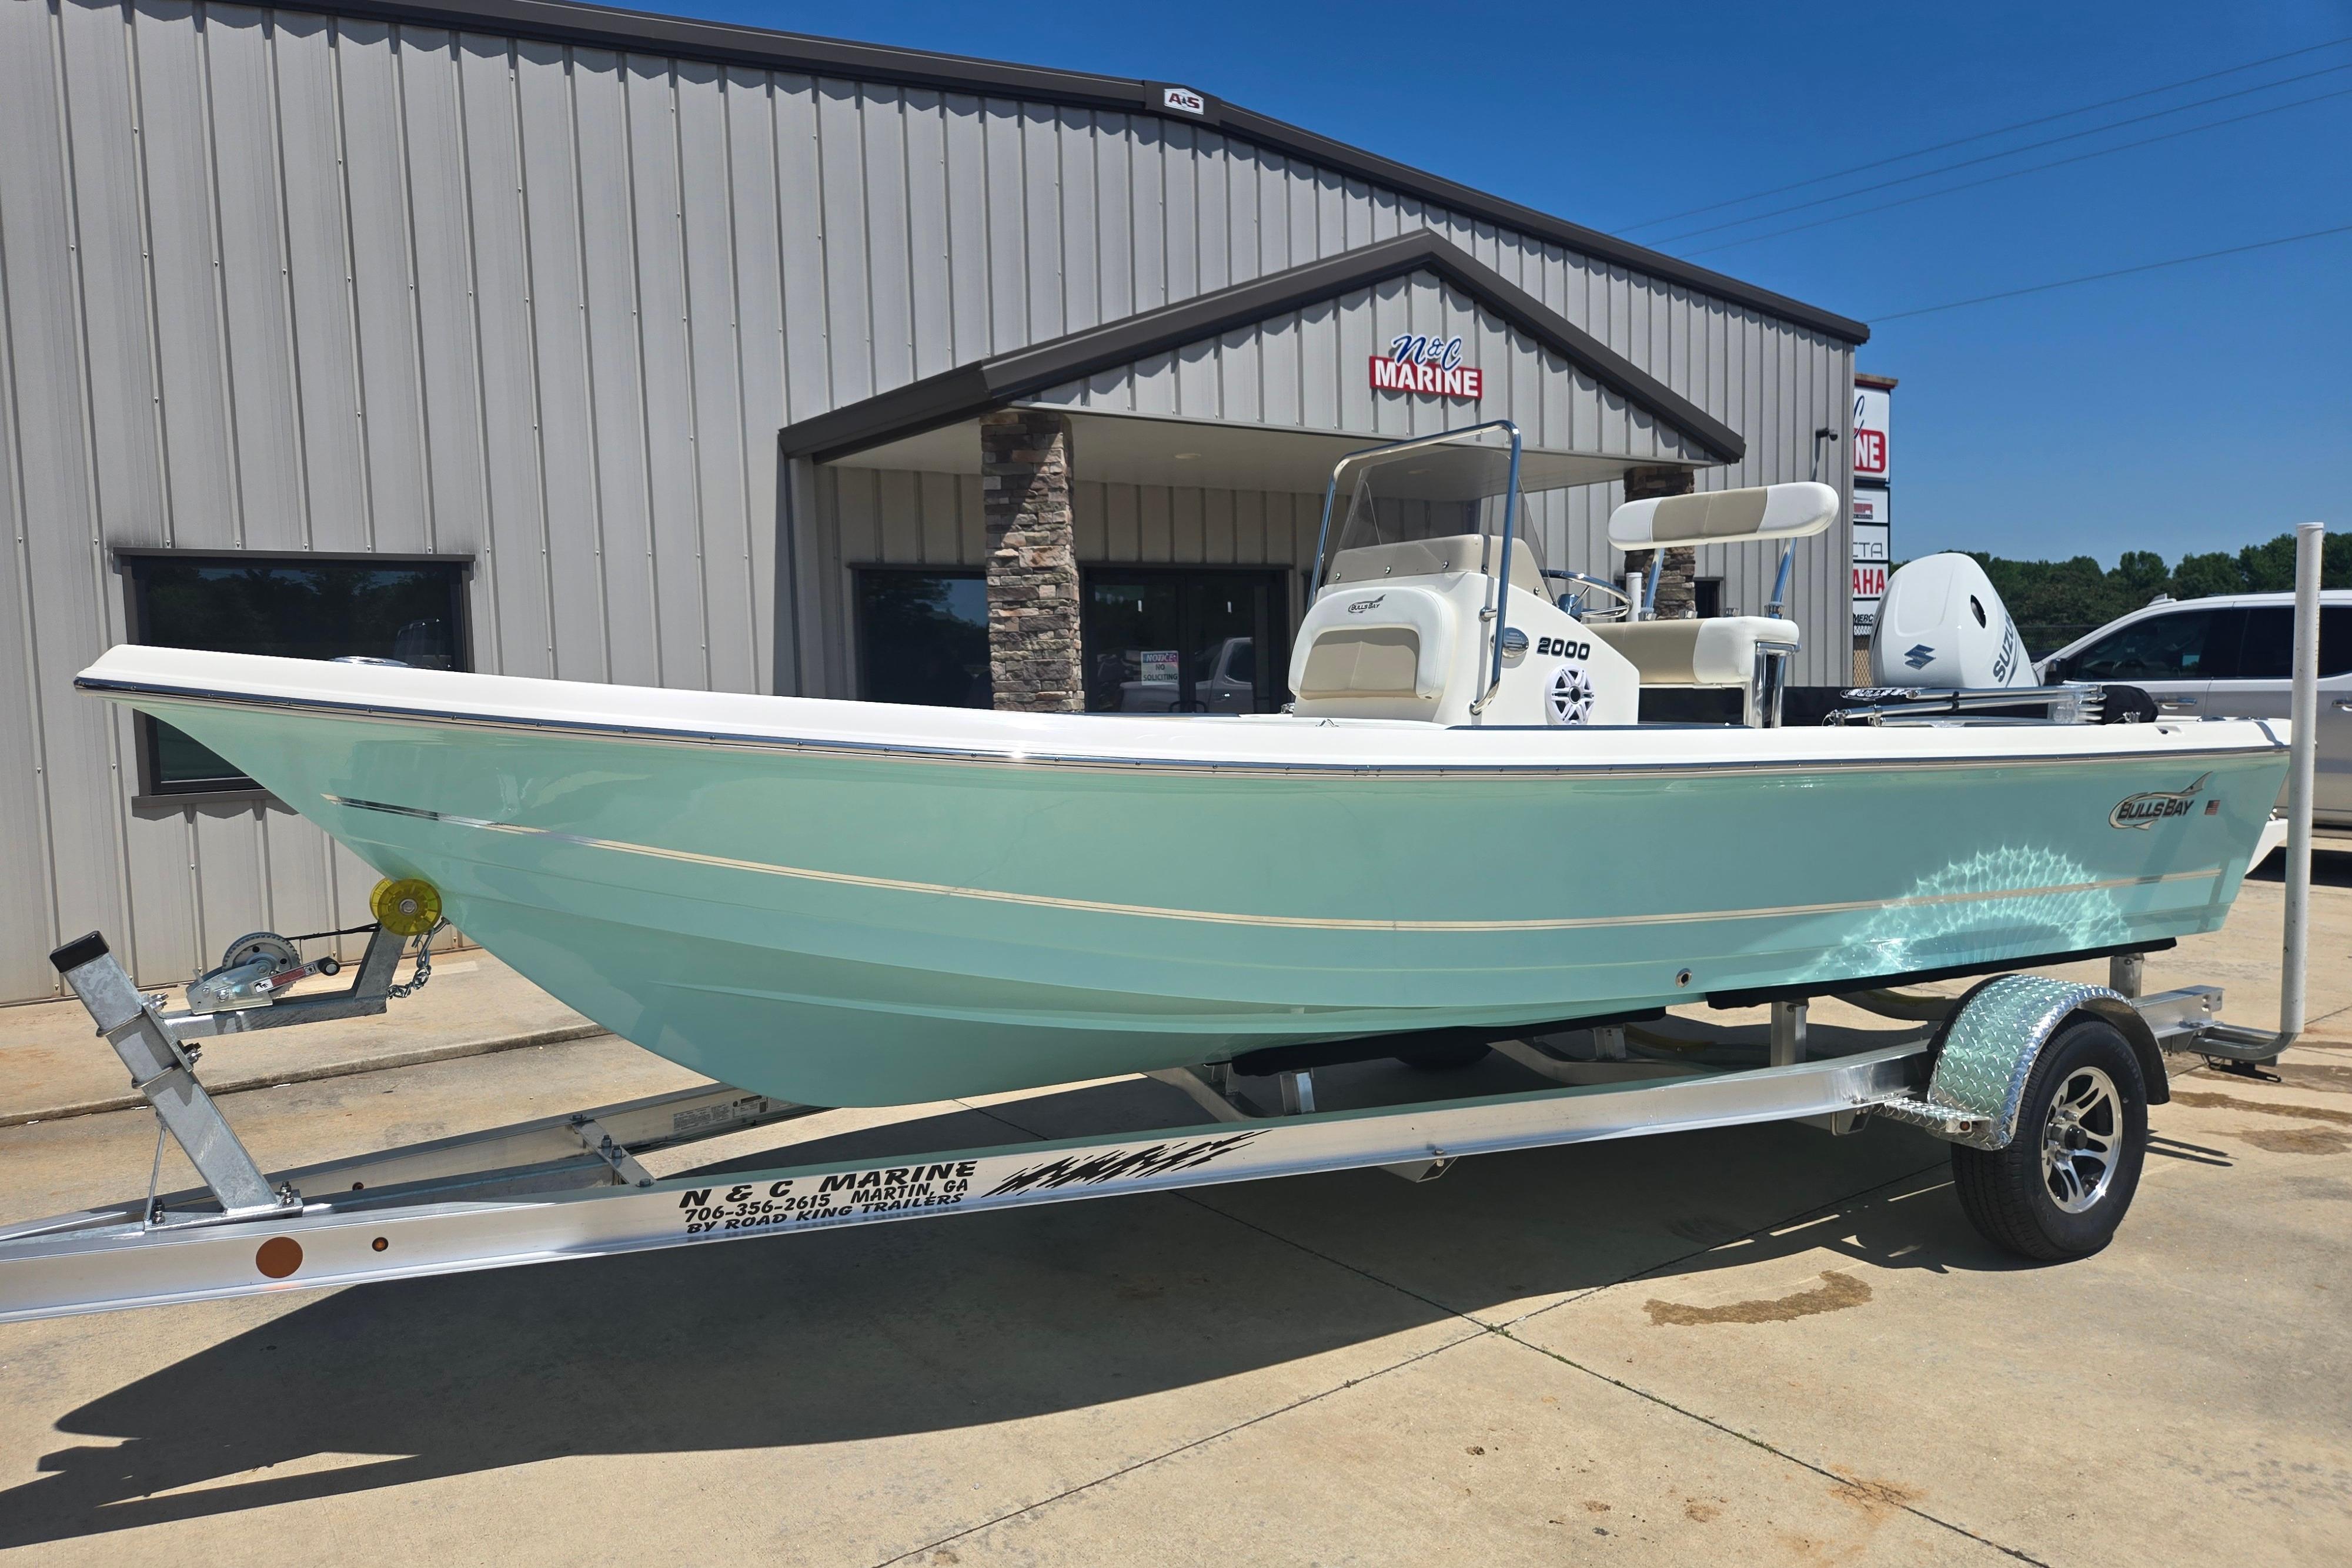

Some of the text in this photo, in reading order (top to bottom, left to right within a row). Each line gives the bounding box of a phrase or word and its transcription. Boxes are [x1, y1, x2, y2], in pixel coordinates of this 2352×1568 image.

[1375, 360, 1478, 396] MARINE
[1147, 654, 1174, 662] NOTICE
[1536, 637, 1591, 661] 2000
[679, 1161, 978, 1208] N & C MARINE
[684, 1179, 968, 1223] 706-356-2615 MARTIN, GA
[687, 1193, 964, 1233] BY ROAD KING TRAILERS
